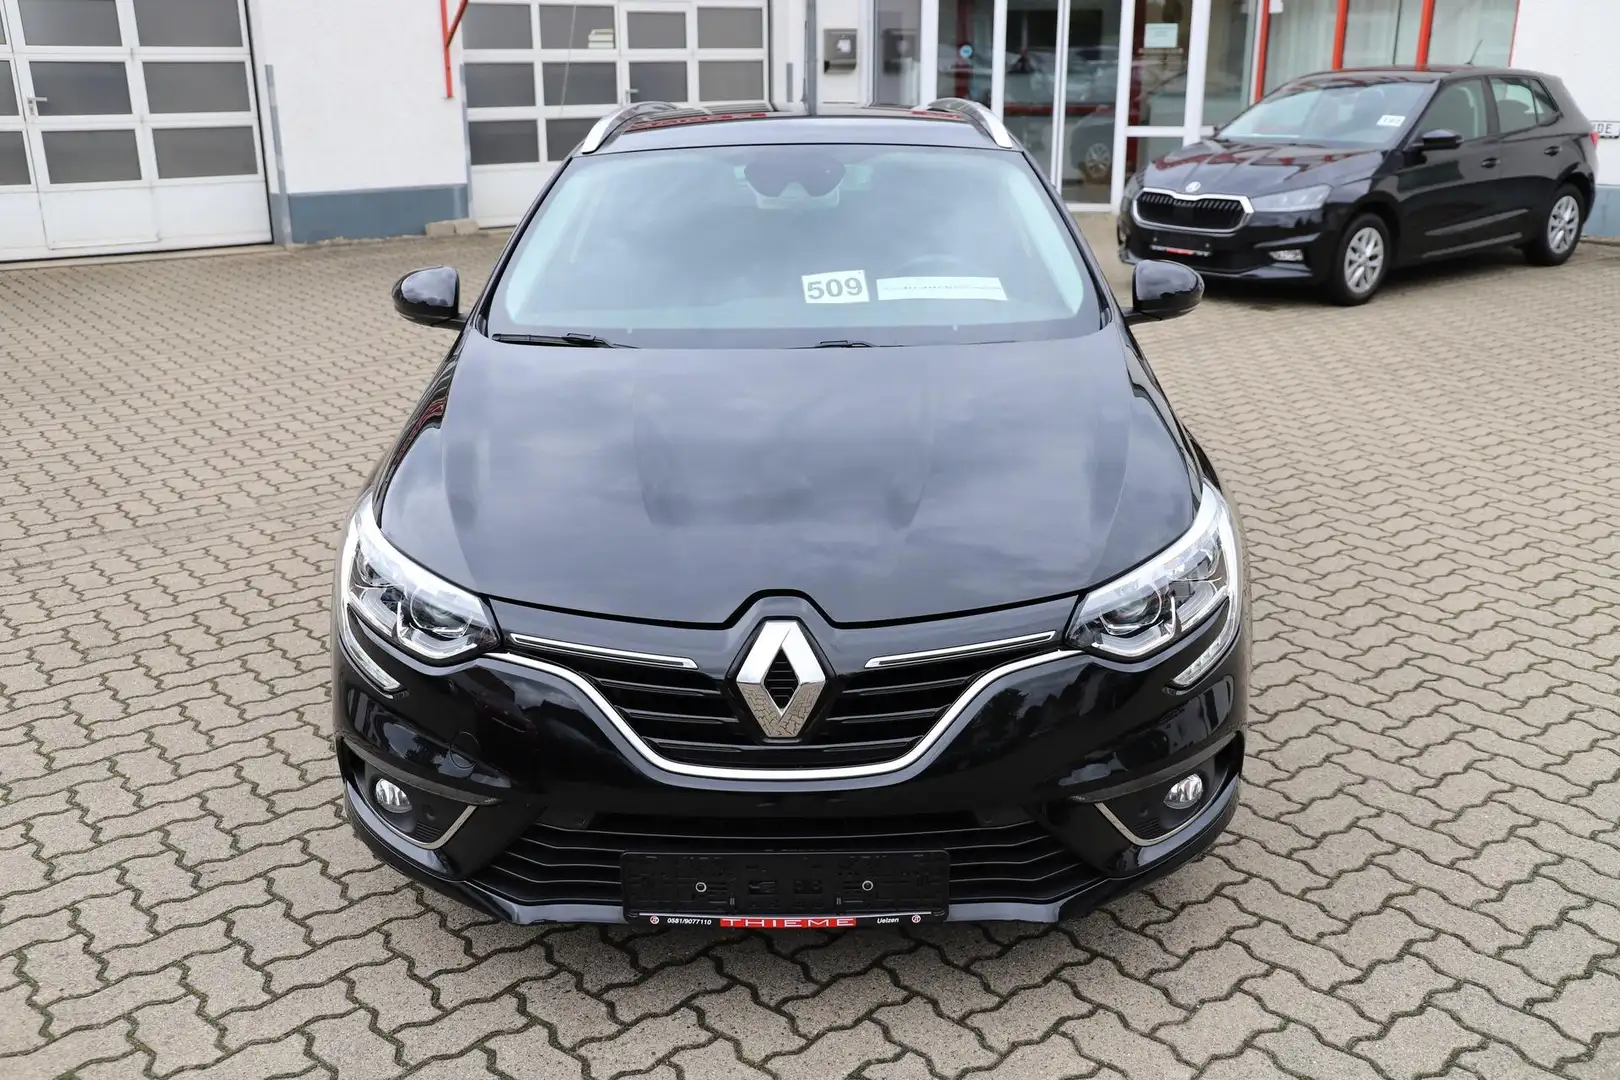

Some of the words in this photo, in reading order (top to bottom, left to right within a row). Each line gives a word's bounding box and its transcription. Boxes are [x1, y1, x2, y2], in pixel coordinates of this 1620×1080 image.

[807, 277, 863, 300] 509
[667, 917, 712, 925] 0581/9077110
[722, 917, 854, 928] THIEME
[876, 917, 900, 925] Uelzen
